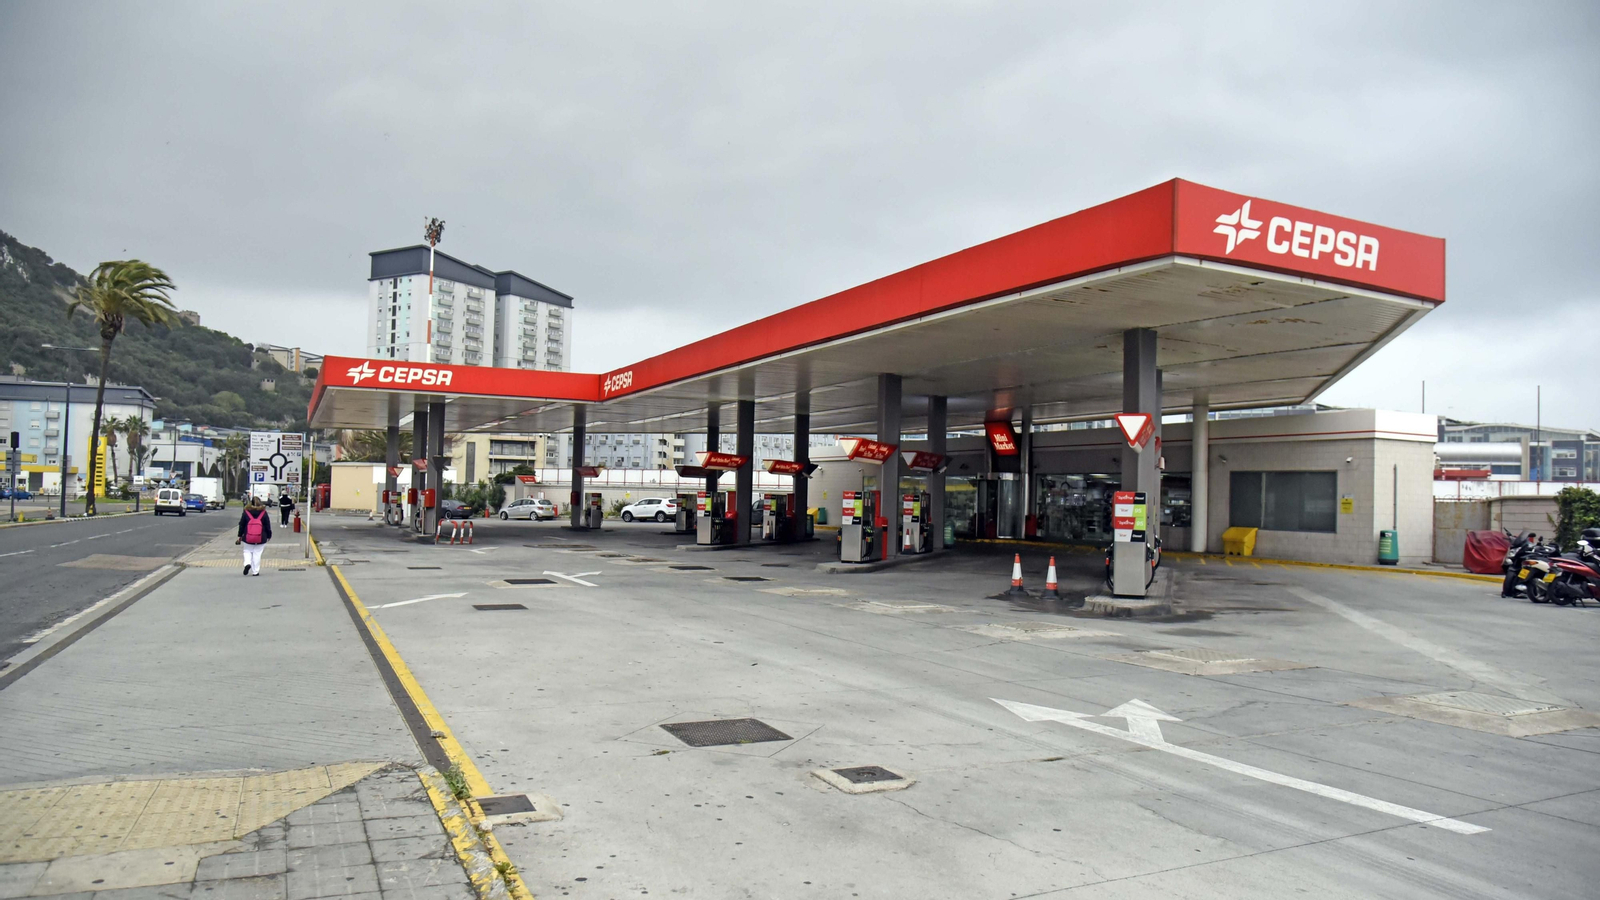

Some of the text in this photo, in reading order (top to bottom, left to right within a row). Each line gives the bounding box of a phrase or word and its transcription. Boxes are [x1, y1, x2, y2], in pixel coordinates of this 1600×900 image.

[1266, 216, 1379, 271] CEPSA
[378, 366, 453, 386] CEPSA
[611, 370, 633, 392] CEPSA
[993, 433, 1008, 442] Mini
[993, 441, 1015, 450] Market
[256, 473, 263, 481] P
